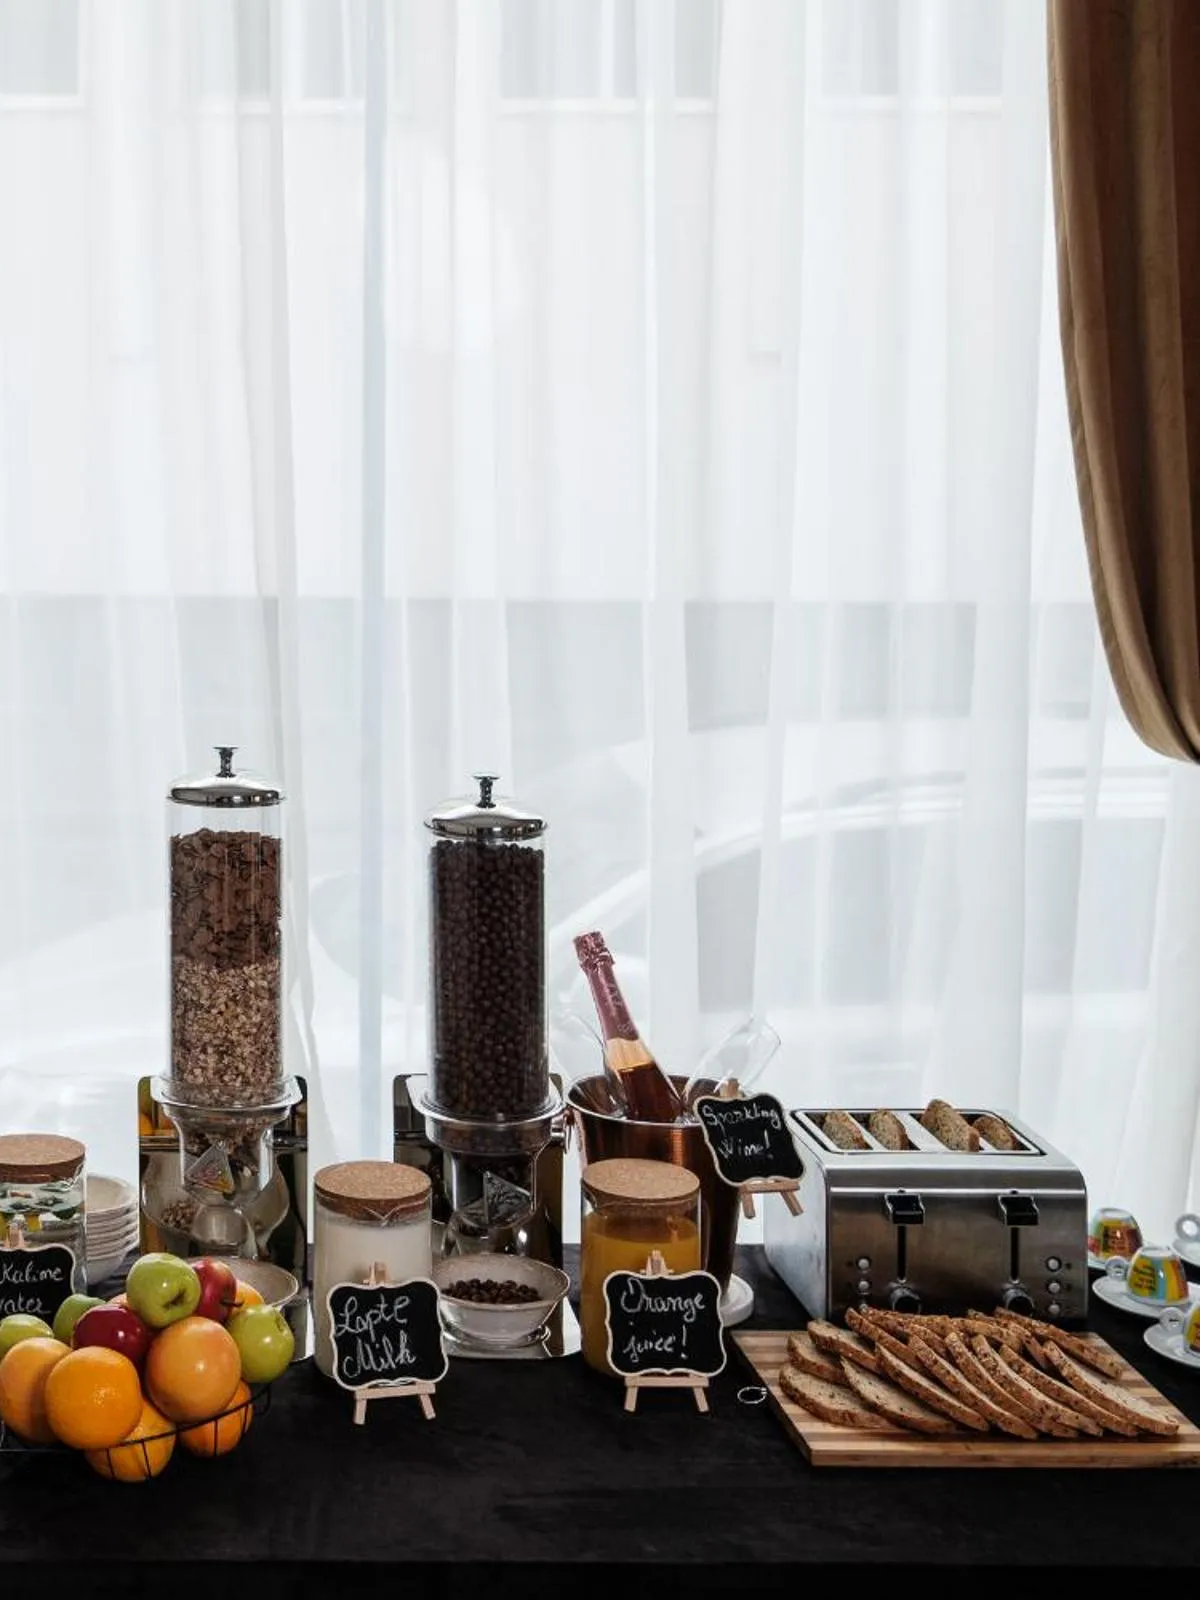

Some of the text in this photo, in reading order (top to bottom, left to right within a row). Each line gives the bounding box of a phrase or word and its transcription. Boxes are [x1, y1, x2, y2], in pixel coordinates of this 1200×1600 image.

[335, 1293, 410, 1342] Lapte
[620, 1277, 705, 1322] Orange
[343, 1330, 416, 1378] Milk
